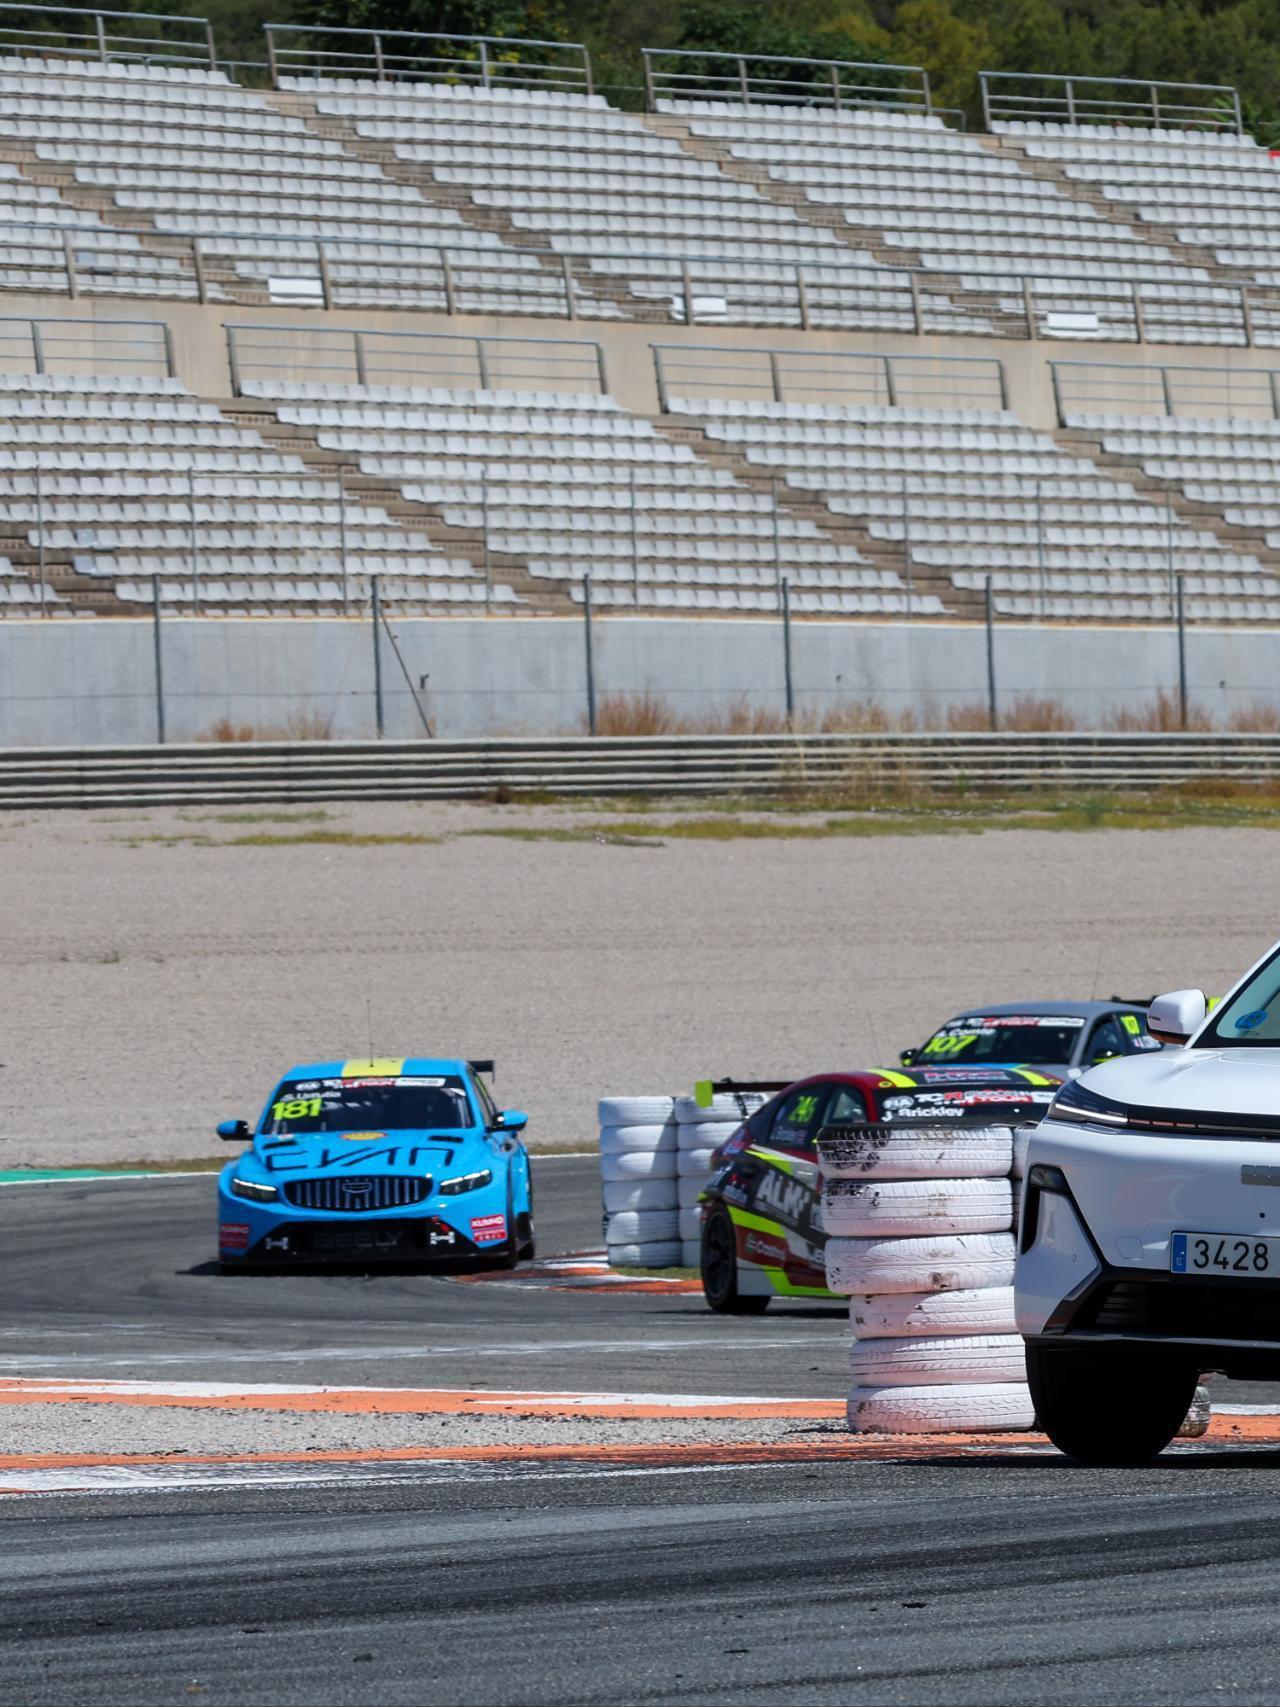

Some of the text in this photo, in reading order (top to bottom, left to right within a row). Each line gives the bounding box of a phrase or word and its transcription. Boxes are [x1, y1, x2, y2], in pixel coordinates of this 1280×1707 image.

[924, 1035, 979, 1054] 107
[272, 1098, 322, 1121] 181
[1193, 1239, 1269, 1272] 3428
